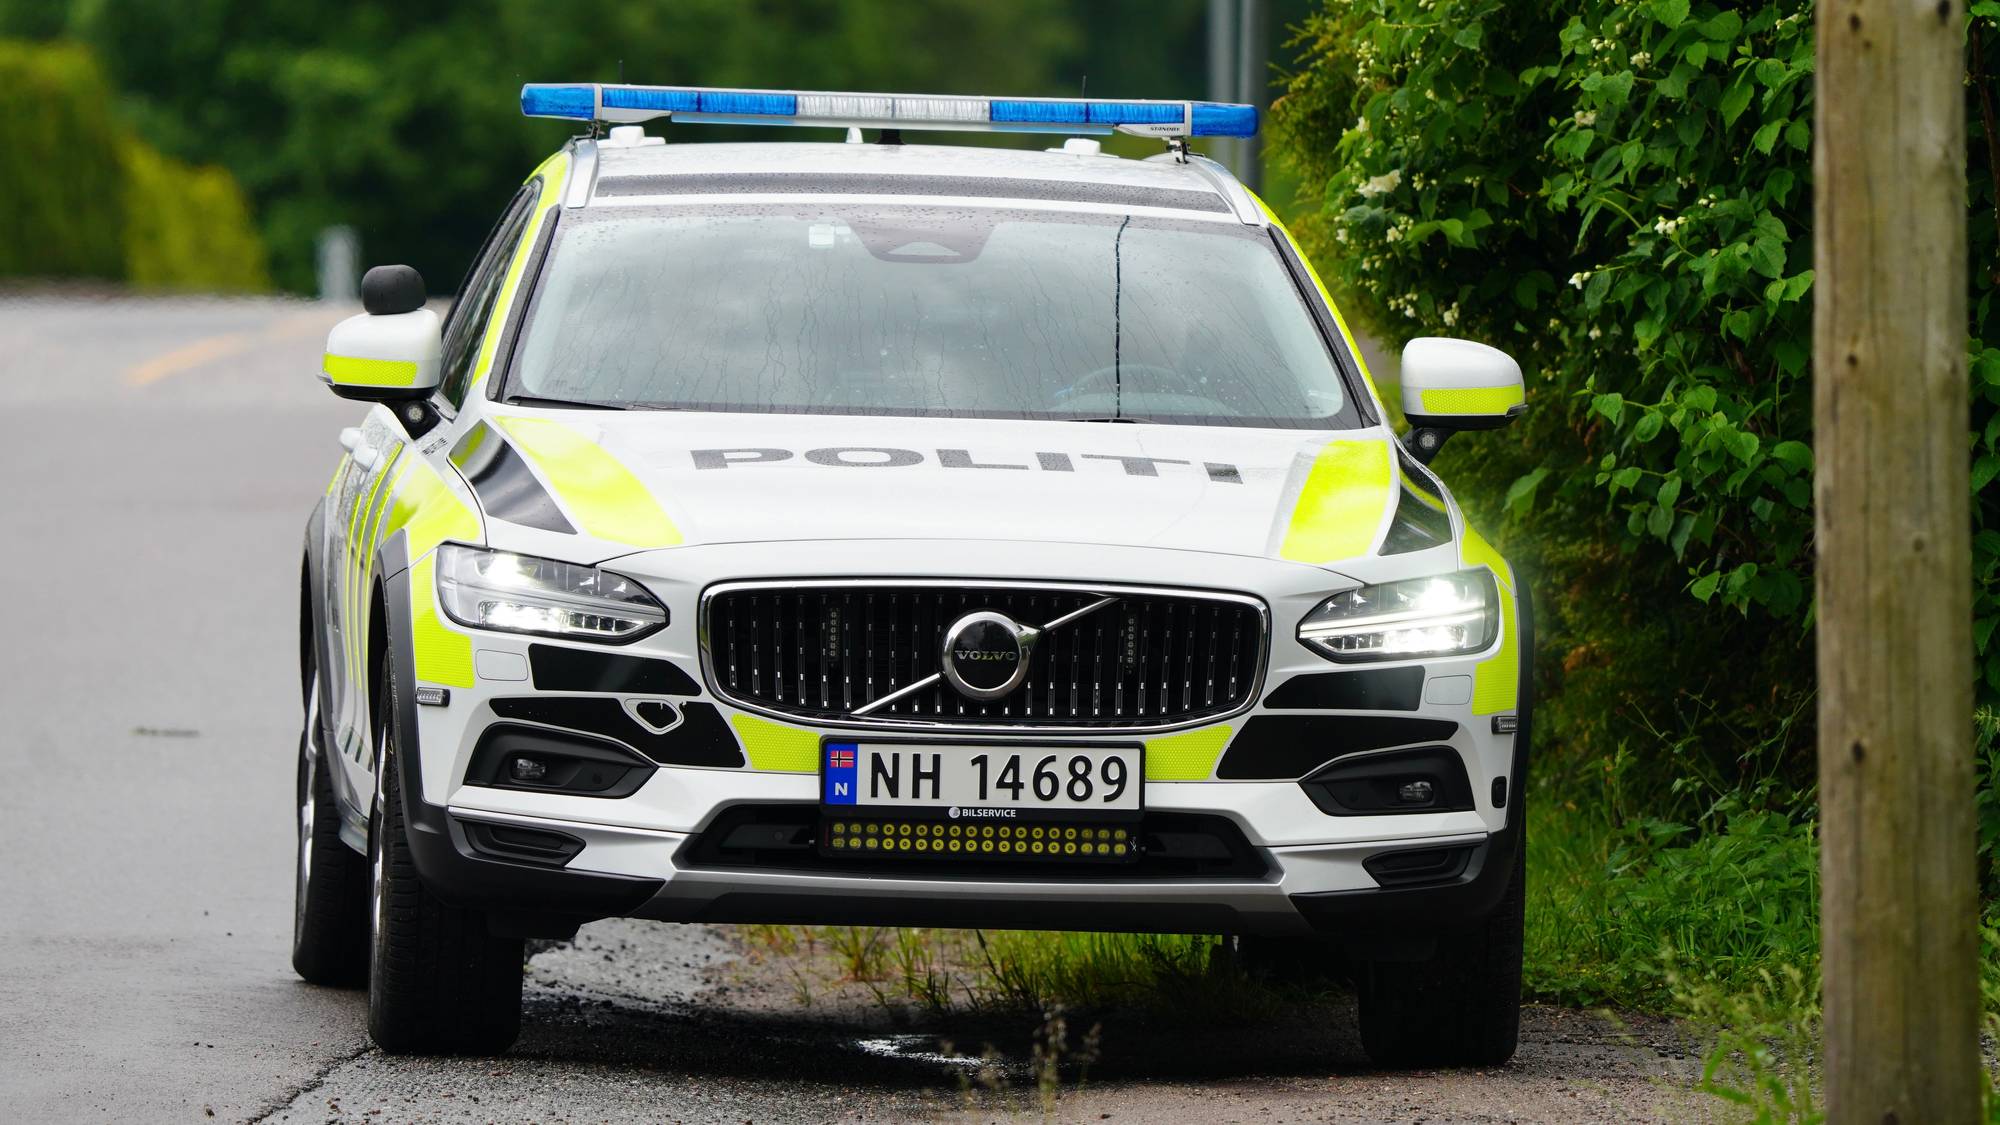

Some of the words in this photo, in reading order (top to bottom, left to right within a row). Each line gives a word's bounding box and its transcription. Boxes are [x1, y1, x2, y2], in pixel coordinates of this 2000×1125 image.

[690, 447, 1244, 485] POLITI
[954, 650, 1017, 661] VOLVO
[870, 752, 941, 800] NH
[970, 754, 1128, 803] 14689
[834, 782, 849, 796] N
[962, 808, 1017, 818] BILSERVICE
